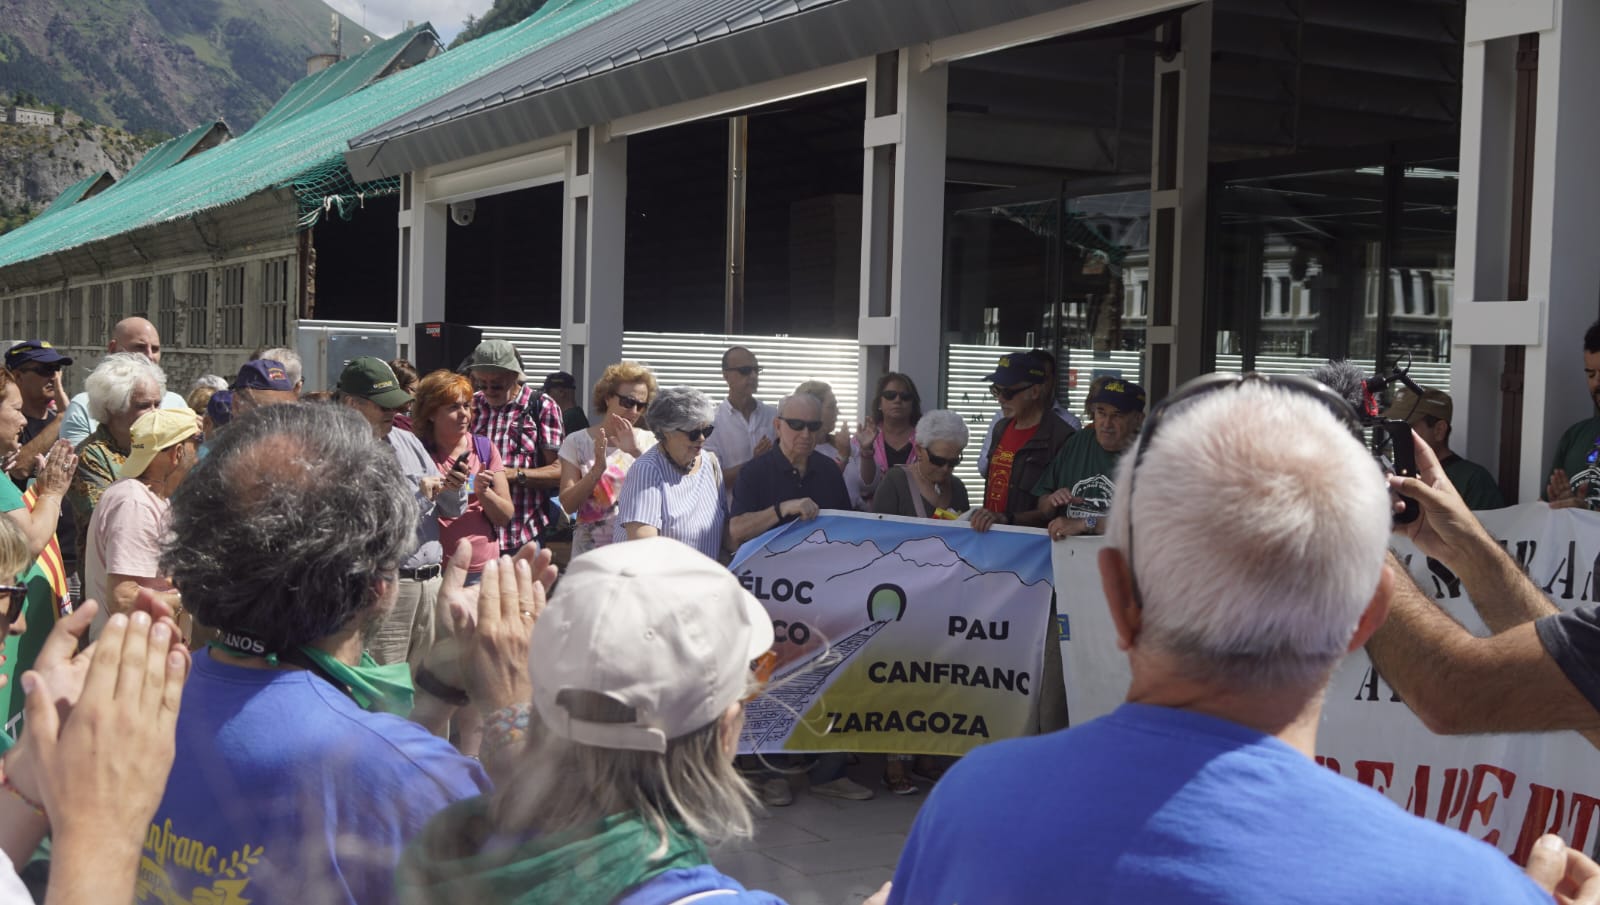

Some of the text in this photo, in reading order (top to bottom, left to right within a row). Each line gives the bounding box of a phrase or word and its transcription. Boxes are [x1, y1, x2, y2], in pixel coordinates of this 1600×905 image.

[738, 569, 814, 605] ÉLOC
[948, 615, 1009, 641] PAU
[868, 661, 1030, 695] CANFRANC
[826, 710, 990, 738] ZARAGOZA
[144, 818, 217, 875] nfranc
